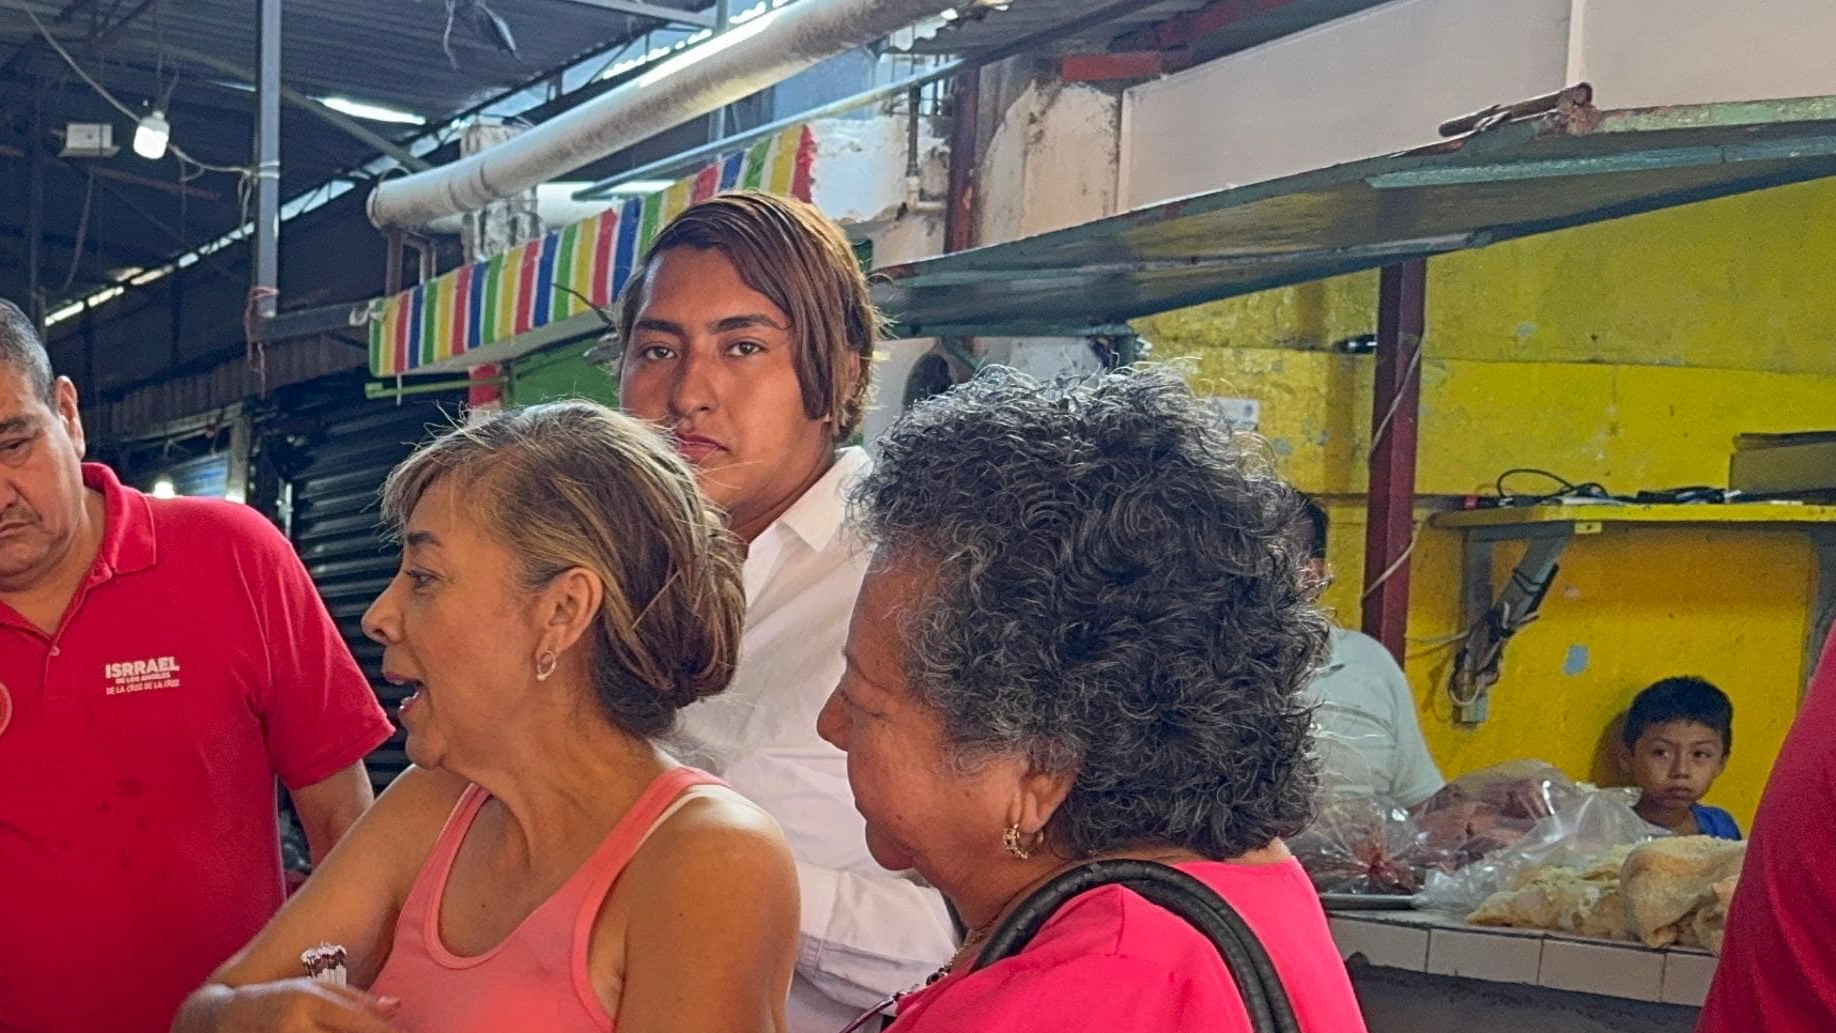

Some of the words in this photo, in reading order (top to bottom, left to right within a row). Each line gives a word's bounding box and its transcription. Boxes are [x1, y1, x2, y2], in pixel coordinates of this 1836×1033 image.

[105, 656, 181, 680] ISRRAEL
[106, 686, 115, 695] DE
[116, 685, 126, 694] LA
[154, 679, 163, 689] LA
